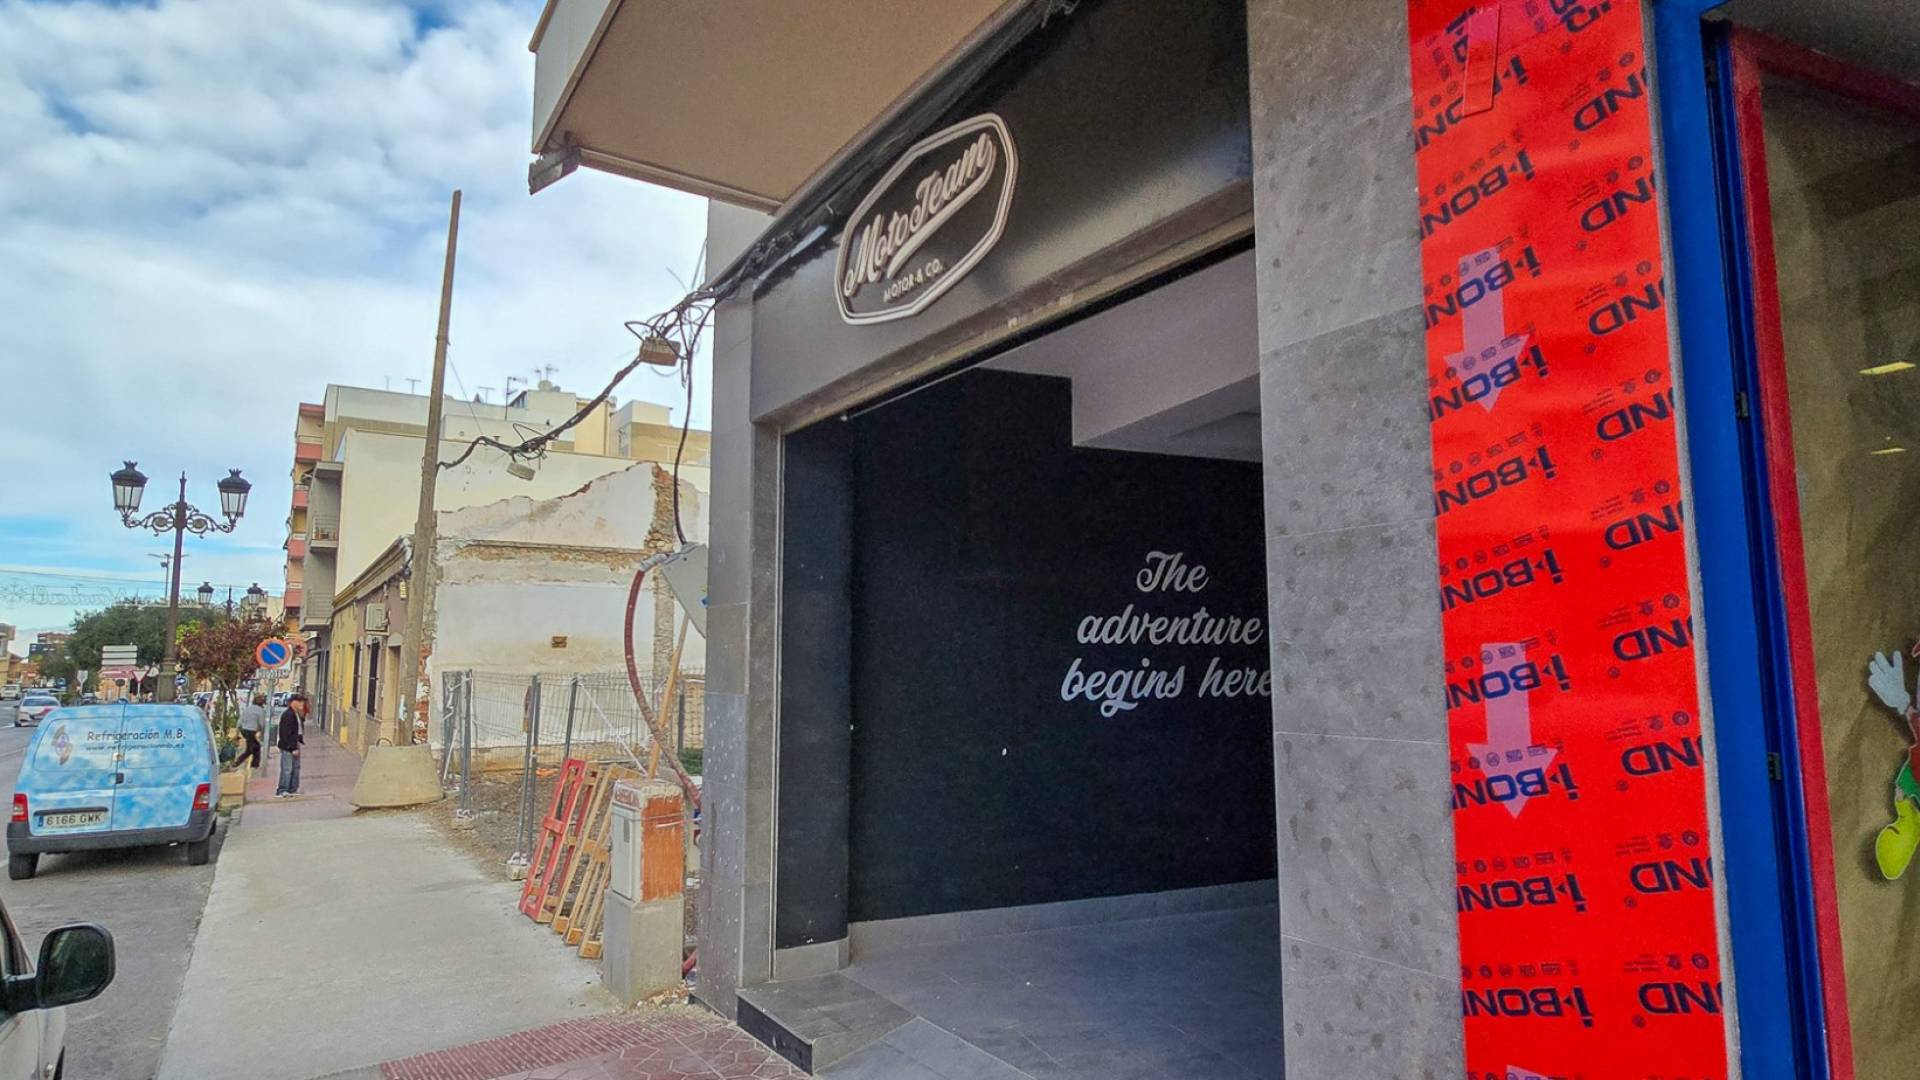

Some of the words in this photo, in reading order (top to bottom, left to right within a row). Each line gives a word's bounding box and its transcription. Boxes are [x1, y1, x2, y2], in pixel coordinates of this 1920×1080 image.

[1136, 551, 1209, 592] The
[1077, 604, 1264, 645] adventure
[1061, 657, 1186, 718] begins
[1198, 657, 1273, 698] here
[87, 729, 160, 743] Refrigeración
[163, 728, 186, 740] M.B.
[46, 815, 76, 826] 6166
[79, 812, 102, 824] GWK
